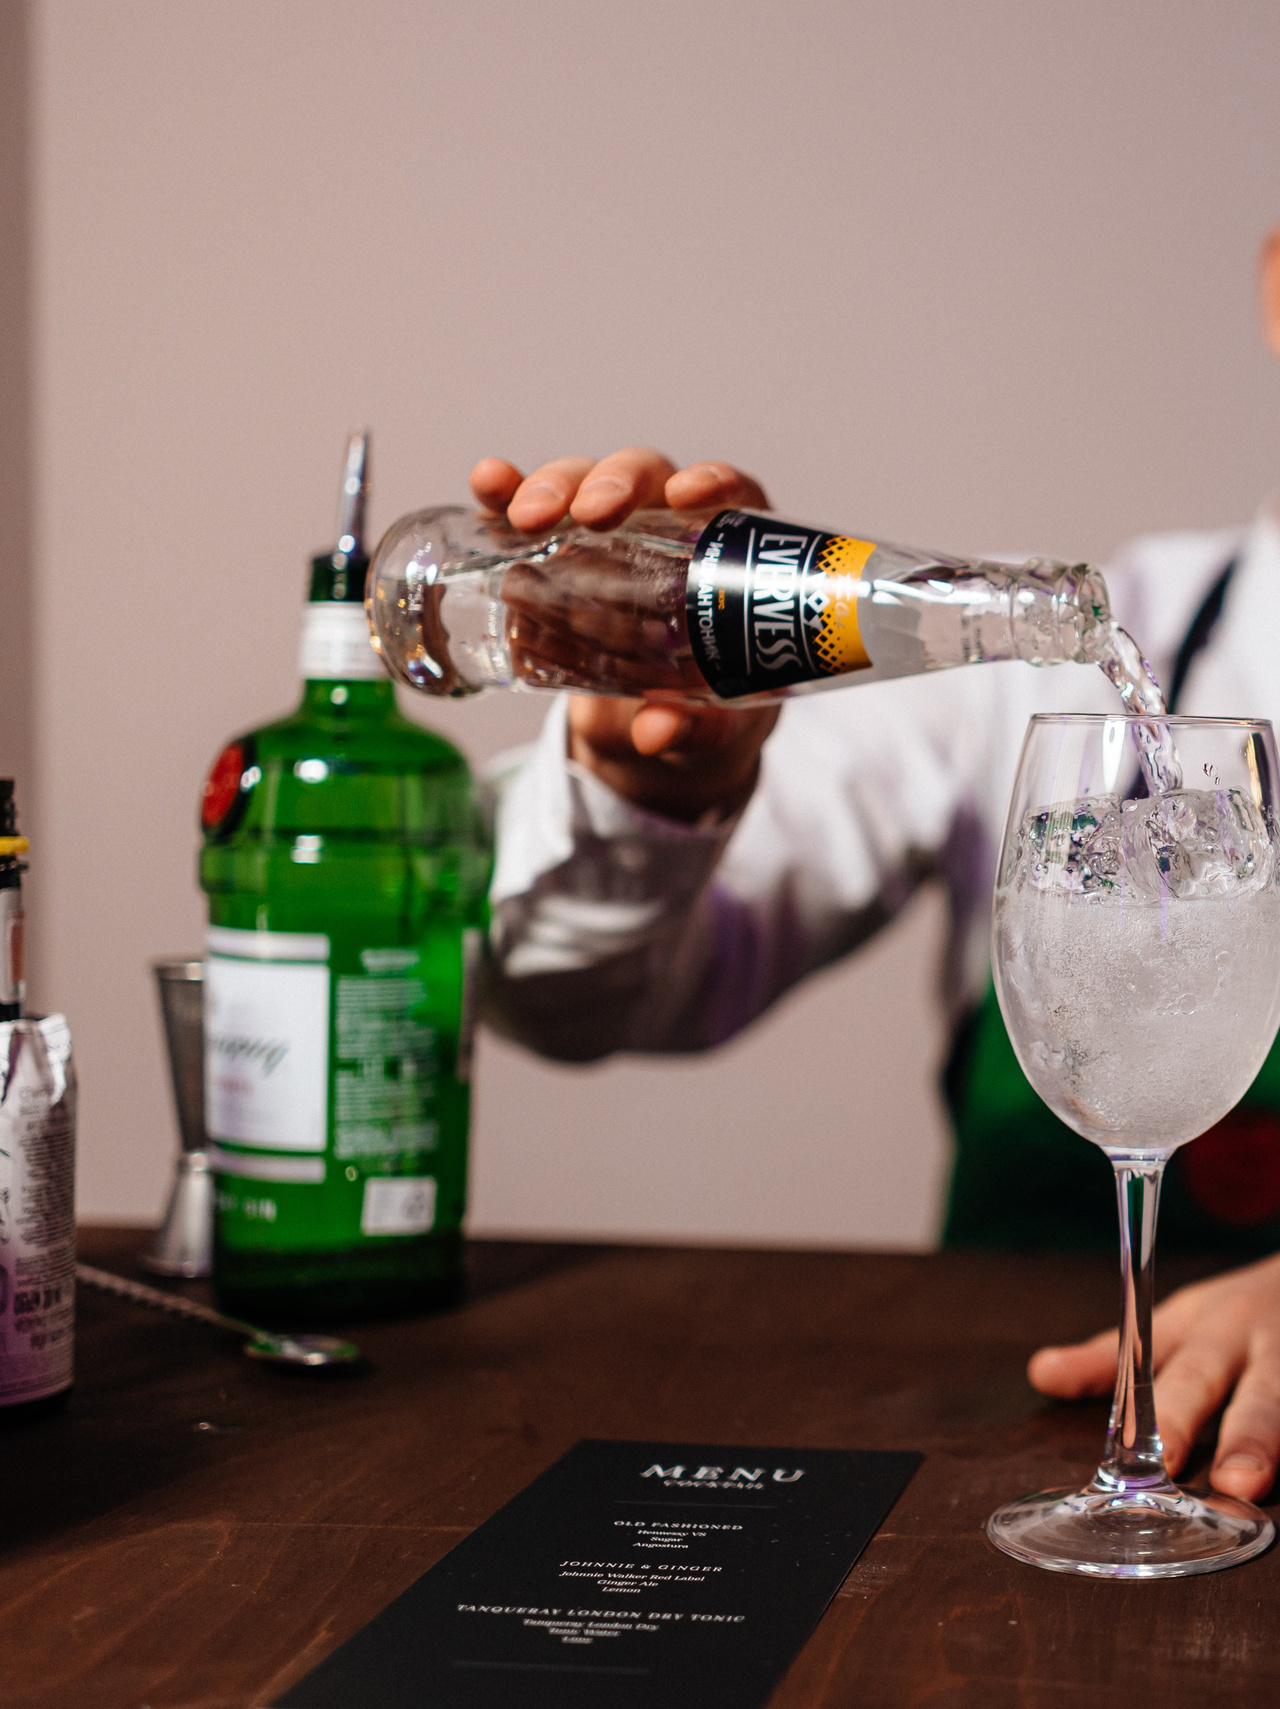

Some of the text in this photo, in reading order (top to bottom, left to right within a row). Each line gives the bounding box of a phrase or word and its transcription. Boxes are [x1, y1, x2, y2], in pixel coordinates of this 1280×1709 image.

[753, 533, 808, 670] EVERVESS
[698, 606, 721, 661] ТОНИК
[641, 1464, 804, 1482] MENU
[638, 1529, 688, 1537] Hennessy
[651, 1522, 743, 1530] FASHIONED
[560, 1561, 634, 1569] JOHNNIE
[658, 1564, 722, 1572] GINGER
[458, 1604, 745, 1622] TANQUERAY LONDON DRY TONIC
[523, 1618, 585, 1628] Tanqueray
[586, 1620, 632, 1630] London
